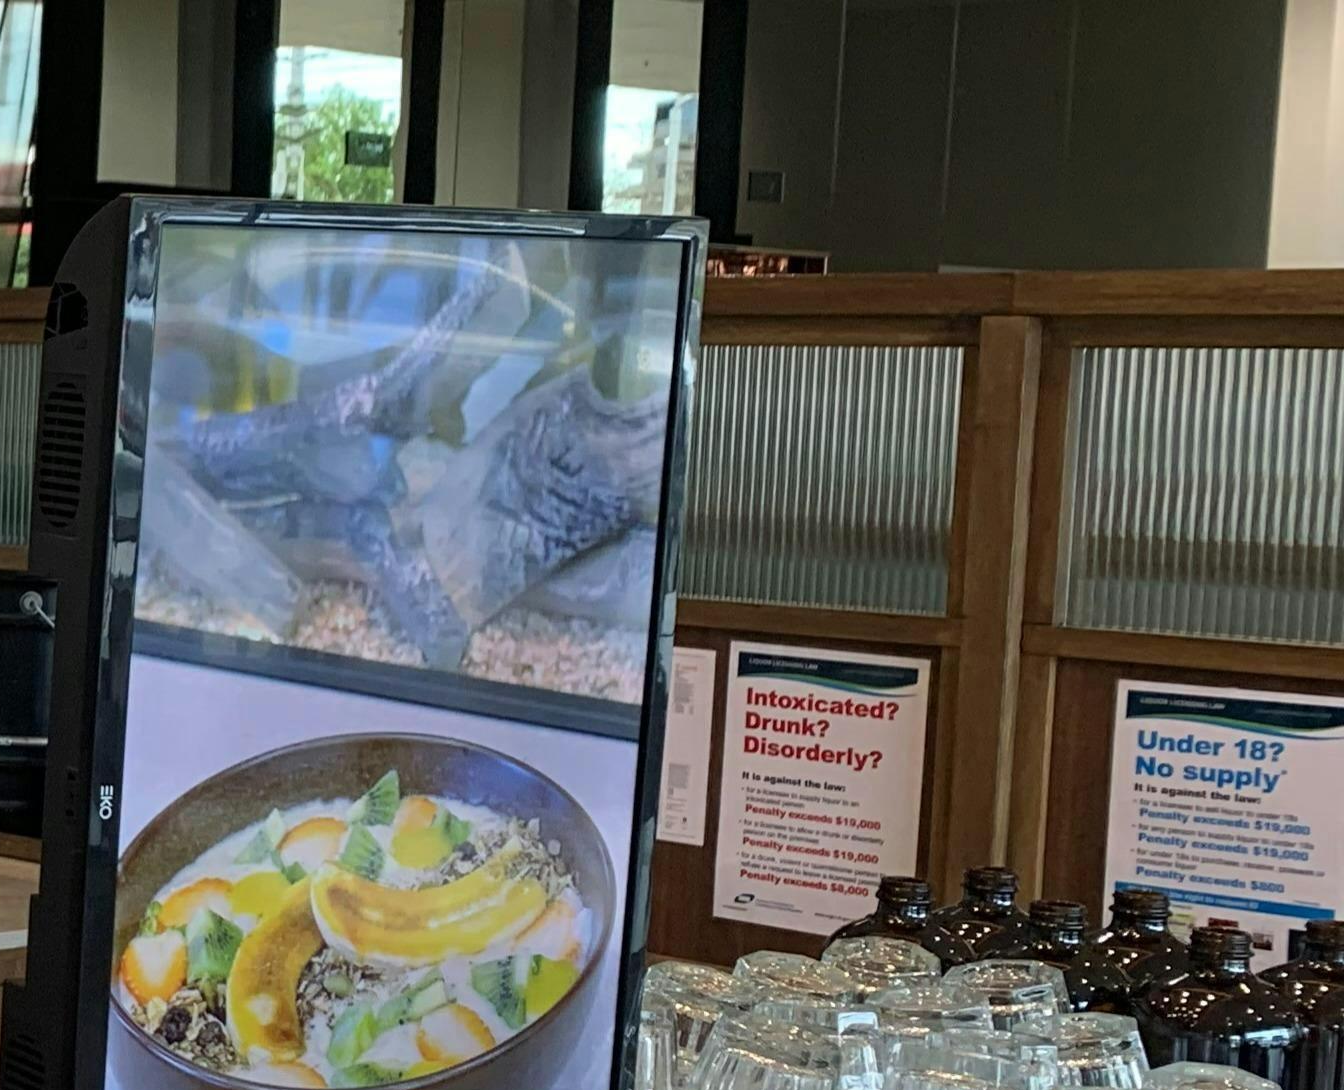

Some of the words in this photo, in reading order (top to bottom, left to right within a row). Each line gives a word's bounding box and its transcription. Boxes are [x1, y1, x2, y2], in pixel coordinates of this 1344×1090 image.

[746, 686, 900, 721] Intoxicated?
[744, 711, 830, 738] Drunk?
[743, 735, 883, 772] Disorderly?
[1137, 729, 1225, 757] Under
[1234, 738, 1285, 762] 18?
[742, 771, 750, 780] It
[752, 772, 761, 781] is
[763, 775, 801, 787] against
[804, 779, 821, 790] the
[1135, 756, 1174, 778] No
[99, 785, 114, 820] EKO
[1160, 786, 1207, 799] against
[1210, 791, 1231, 801] the
[745, 803, 787, 819] Penalty
[788, 811, 833, 825] exceeds
[835, 815, 881, 831] $19,000
[1139, 808, 1189, 824] Penalty
[1193, 815, 1251, 830] exceeds
[742, 836, 784, 852] Penalty
[786, 844, 831, 858] exceeds
[833, 849, 879, 865] $19,000
[1137, 833, 1187, 849] Penalty
[1191, 840, 1249, 855] exceeds
[739, 869, 781, 885] Penalty
[783, 877, 828, 891] exceeds
[830, 882, 869, 897] $8,000
[1135, 866, 1186, 883] Penalty
[1189, 874, 1247, 889] exceeds
